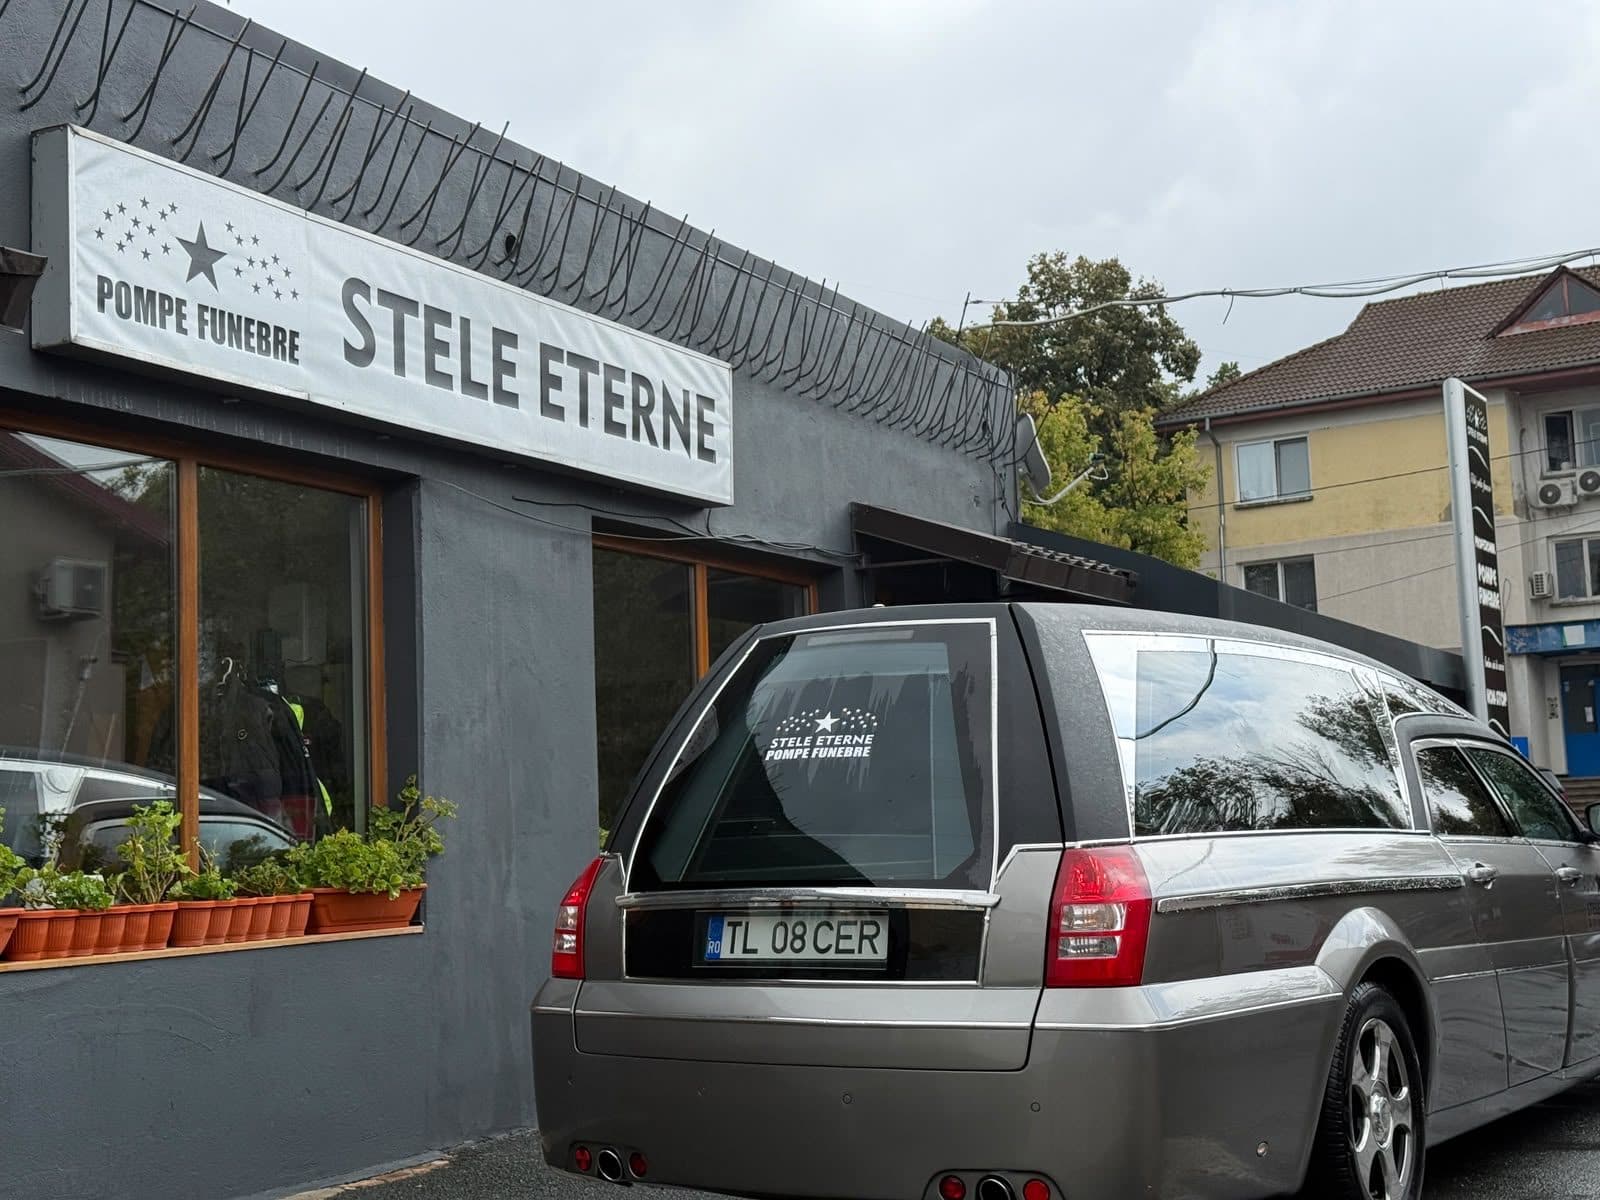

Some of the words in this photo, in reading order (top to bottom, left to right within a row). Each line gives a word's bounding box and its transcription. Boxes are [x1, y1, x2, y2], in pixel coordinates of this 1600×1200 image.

[97, 274, 189, 336] POMPE
[197, 303, 300, 366] FUNEBRE
[341, 276, 520, 410] STELE
[539, 341, 717, 464] ETERNE
[765, 747, 810, 760] POMPE
[811, 746, 871, 759] FUNEBRE
[770, 736, 813, 749] STELE
[816, 734, 875, 746] ETERNE
[707, 940, 721, 954] RO
[727, 921, 758, 954] TL
